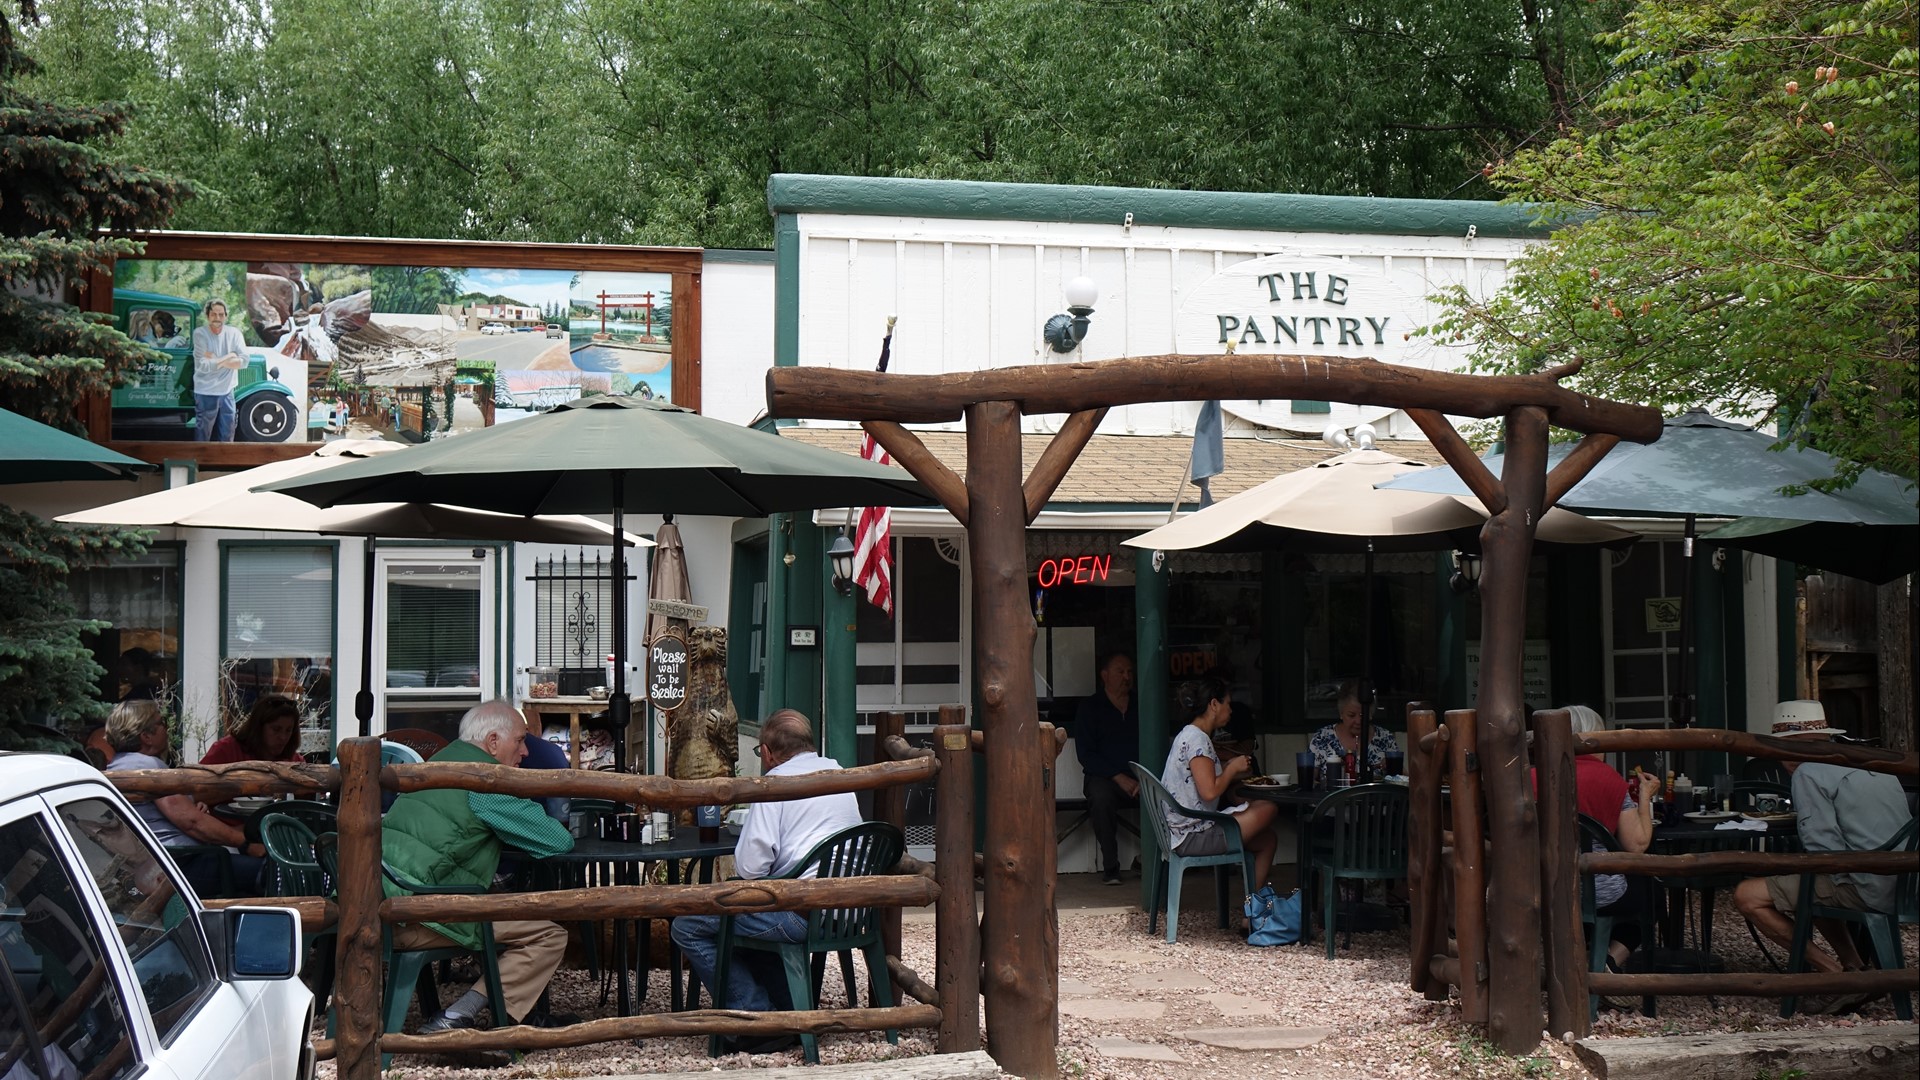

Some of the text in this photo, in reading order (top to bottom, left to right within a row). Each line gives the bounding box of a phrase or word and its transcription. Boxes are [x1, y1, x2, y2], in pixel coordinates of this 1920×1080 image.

[1258, 271, 1349, 306] THE
[1216, 314, 1391, 346] PANTRY
[1038, 554, 1112, 588] OPEN
[649, 602, 703, 619] WELCOME
[653, 647, 687, 664] Please
[1170, 651, 1217, 677] OPEN
[658, 663, 679, 674] wait
[656, 674, 680, 684] To be
[651, 683, 685, 700] Seated
